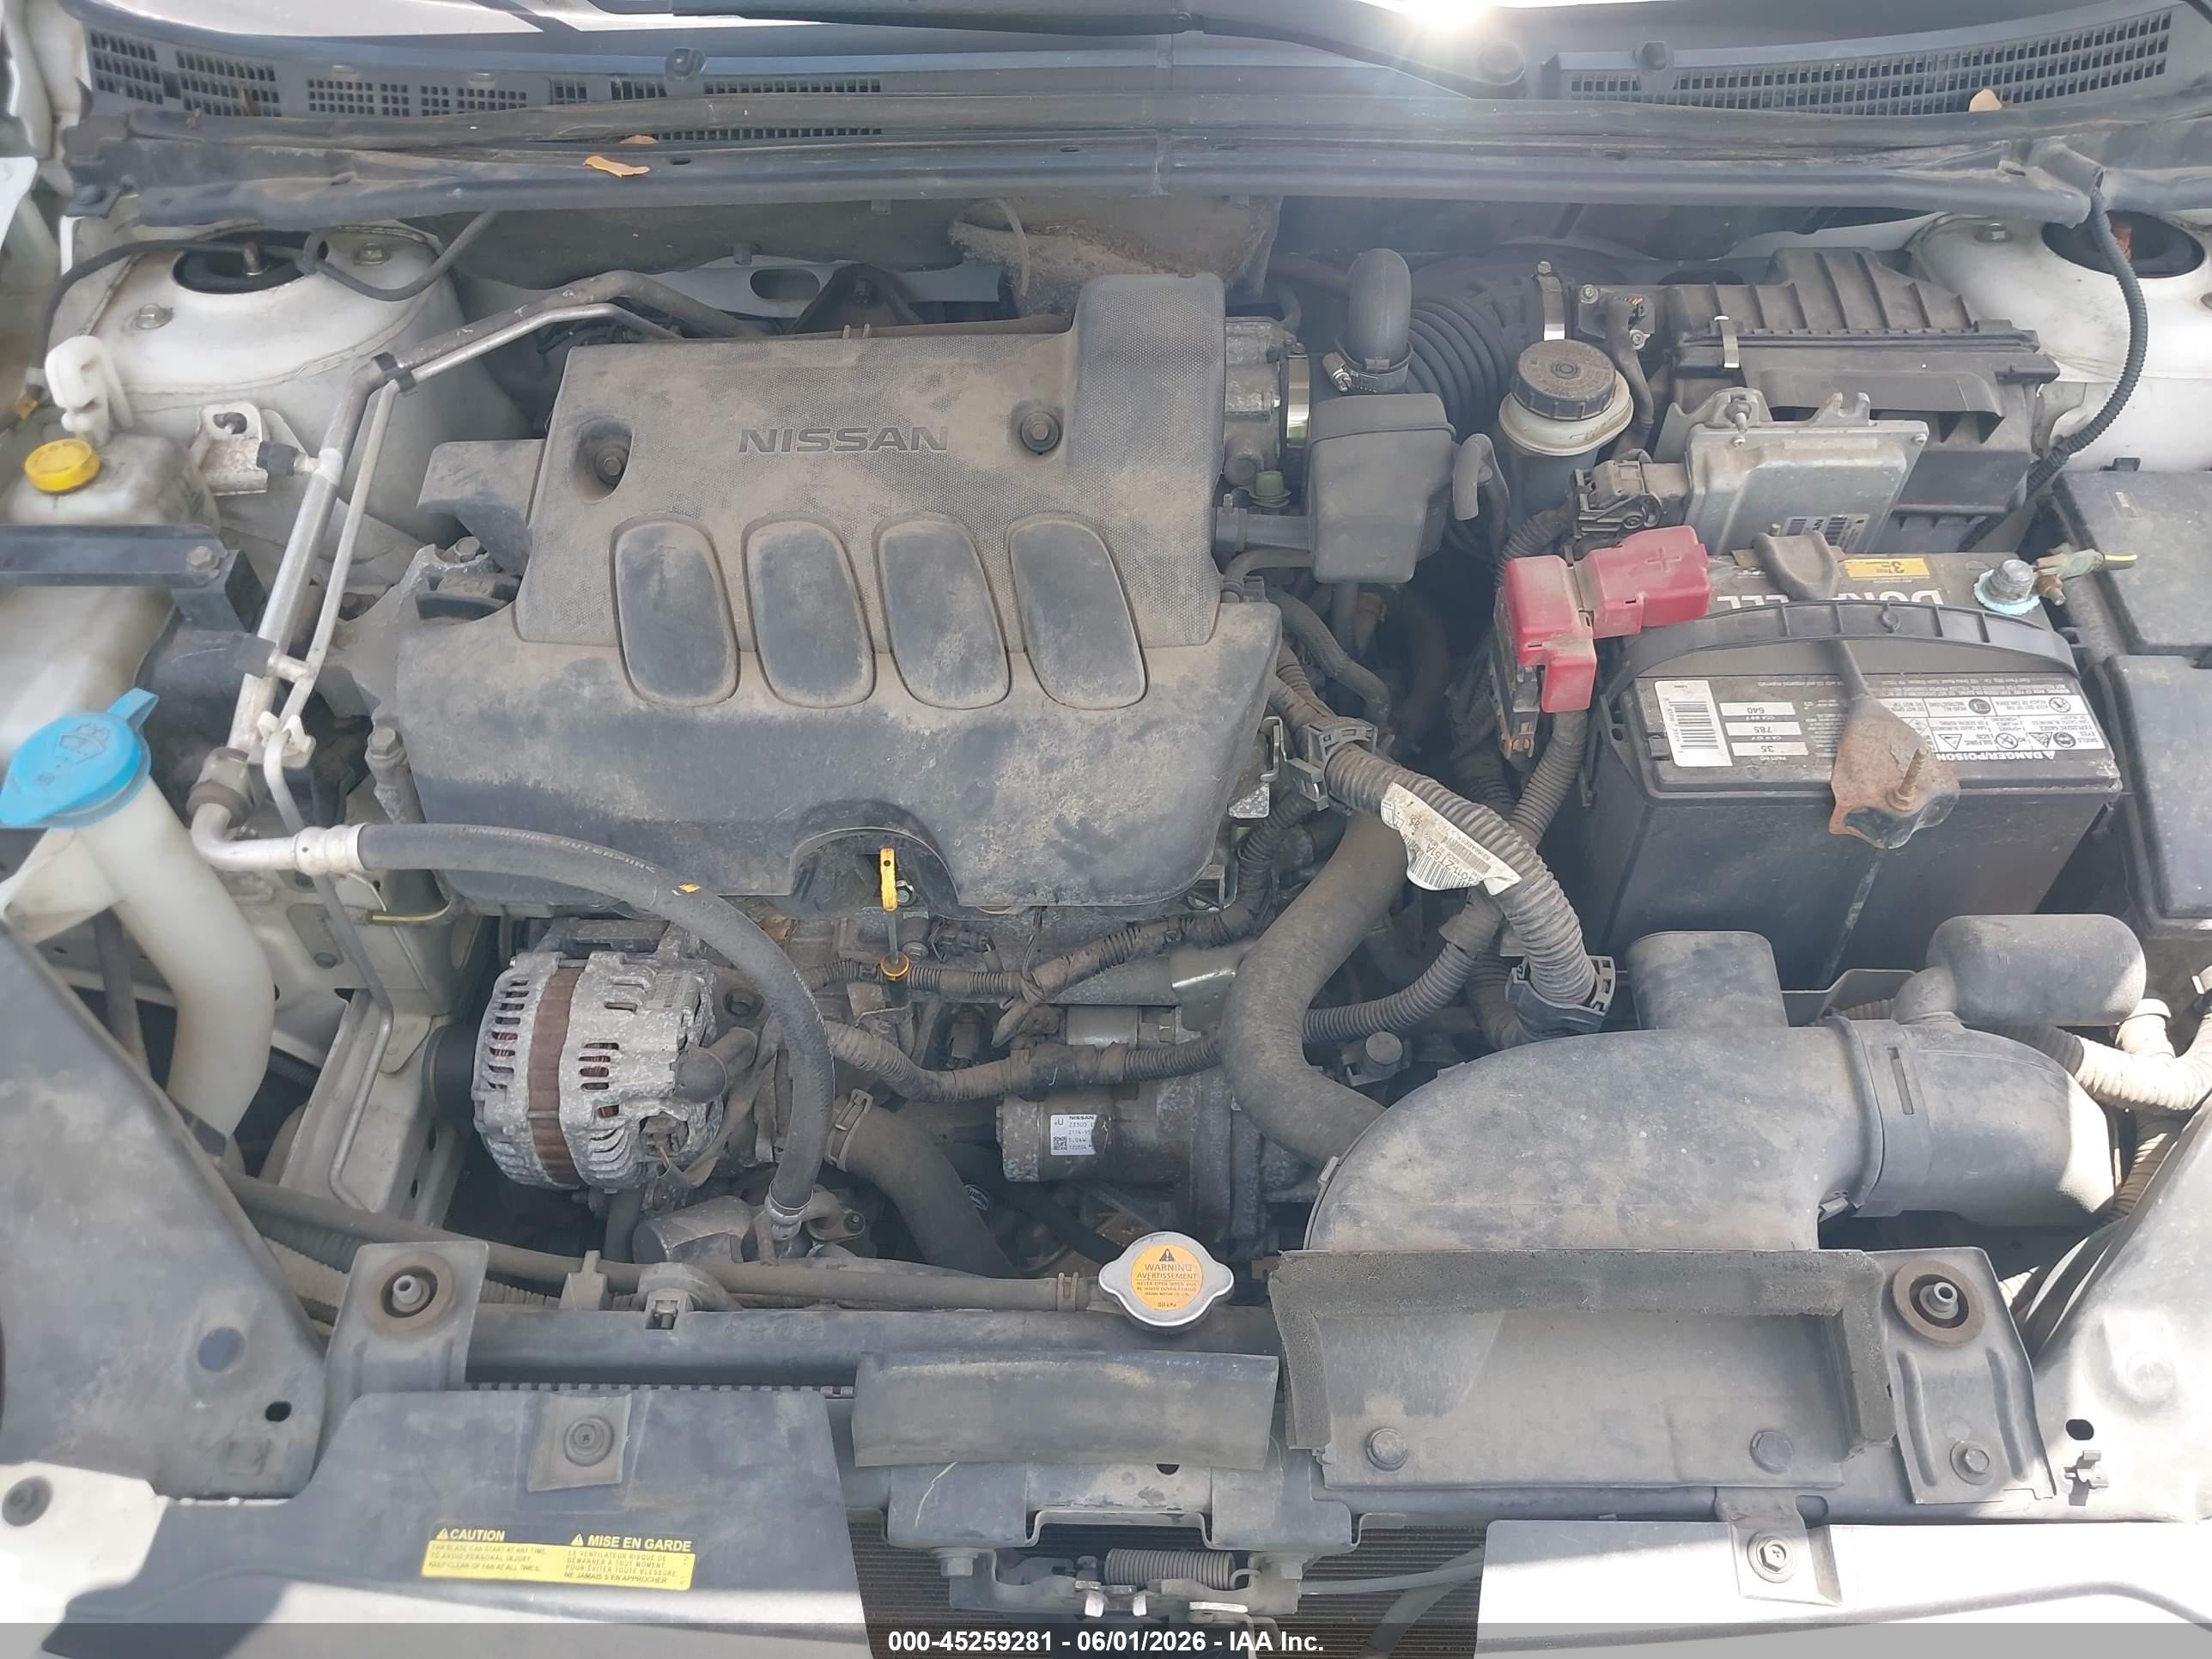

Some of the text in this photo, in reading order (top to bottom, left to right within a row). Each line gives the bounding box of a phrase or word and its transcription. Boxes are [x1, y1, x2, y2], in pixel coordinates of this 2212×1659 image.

[738, 427, 948, 453] NISSAN
[1892, 561, 1905, 574] 3
[1936, 750, 2043, 761] DANGER/POISON
[450, 1528, 505, 1541] CAUTION
[588, 1534, 692, 1552] MISE EN GARDE
